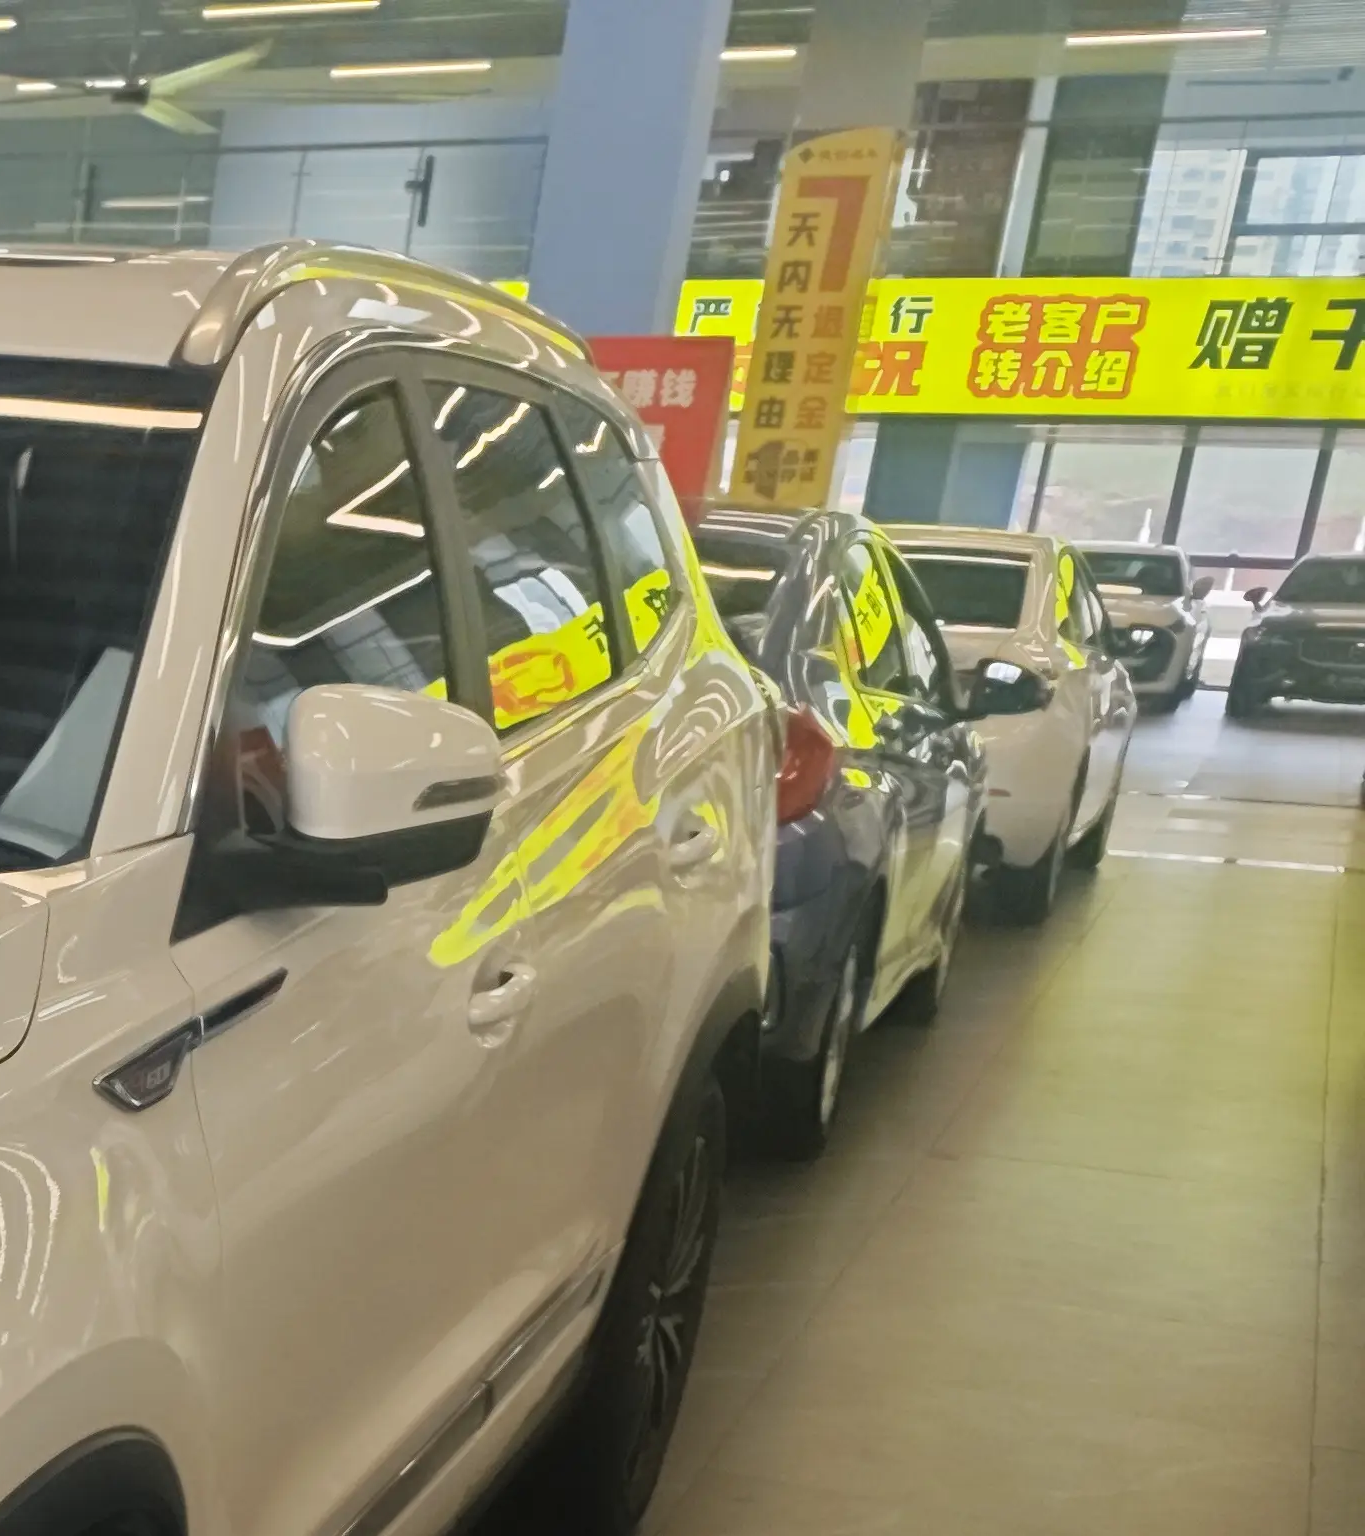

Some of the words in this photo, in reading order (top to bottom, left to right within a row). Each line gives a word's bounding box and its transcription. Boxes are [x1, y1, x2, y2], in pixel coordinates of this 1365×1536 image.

[798, 175, 872, 292] 7
[754, 212, 821, 429] 天内无理由
[793, 305, 845, 429] 退定金
[973, 349, 1132, 393] 转介绍
[984, 300, 1141, 345] 老客户
